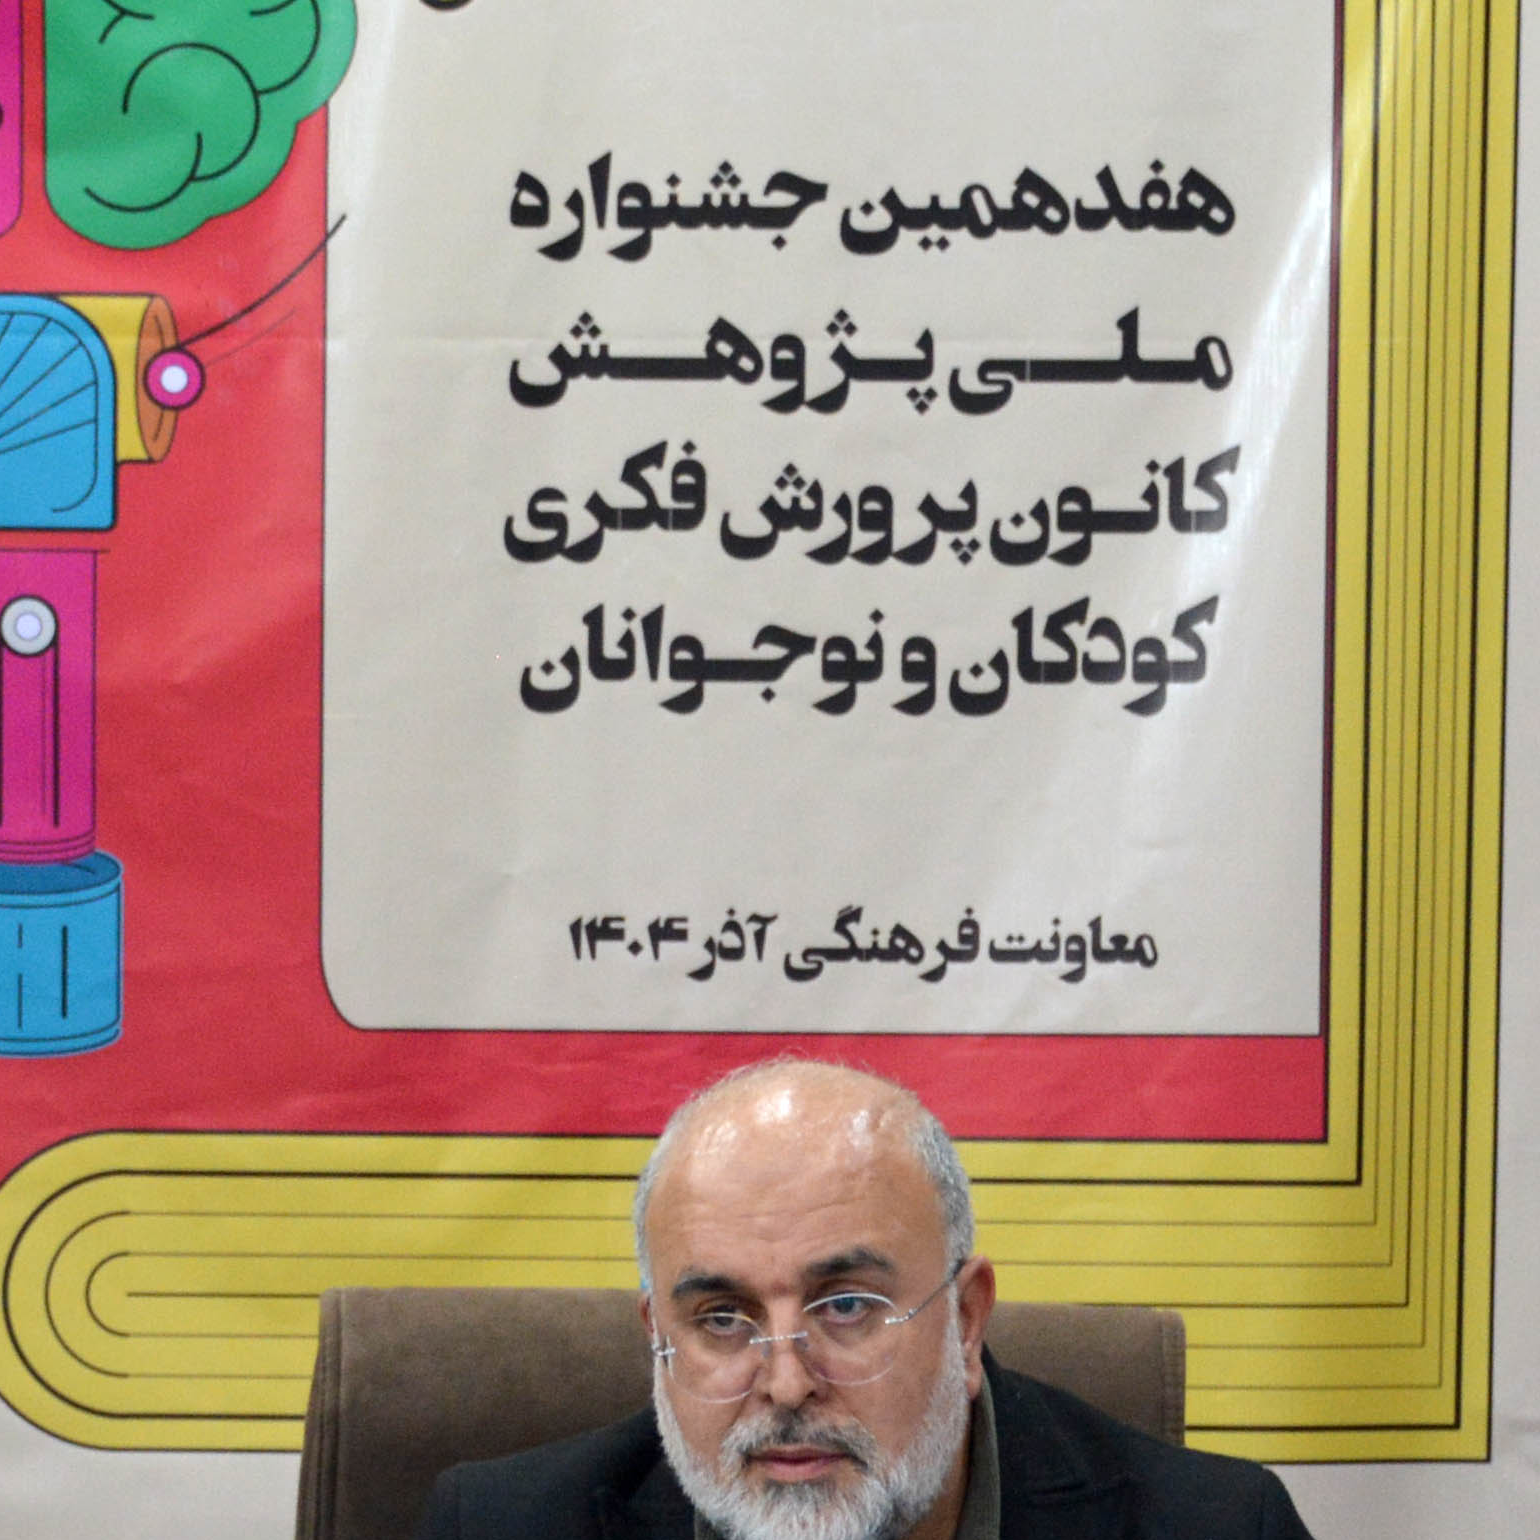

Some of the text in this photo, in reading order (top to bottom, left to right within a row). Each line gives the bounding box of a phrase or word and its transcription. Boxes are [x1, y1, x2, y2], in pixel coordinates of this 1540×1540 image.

[509, 152, 1236, 262] هفدهمین جشنواره
[509, 306, 1233, 415] ملی پژوهش
[503, 440, 1240, 567] کانون پرورش فکری
[519, 596, 1219, 717] کودکان و نوجوانان
[569, 905, 1158, 983] معاونت فرهنگی آذر ۱۴۰۴
